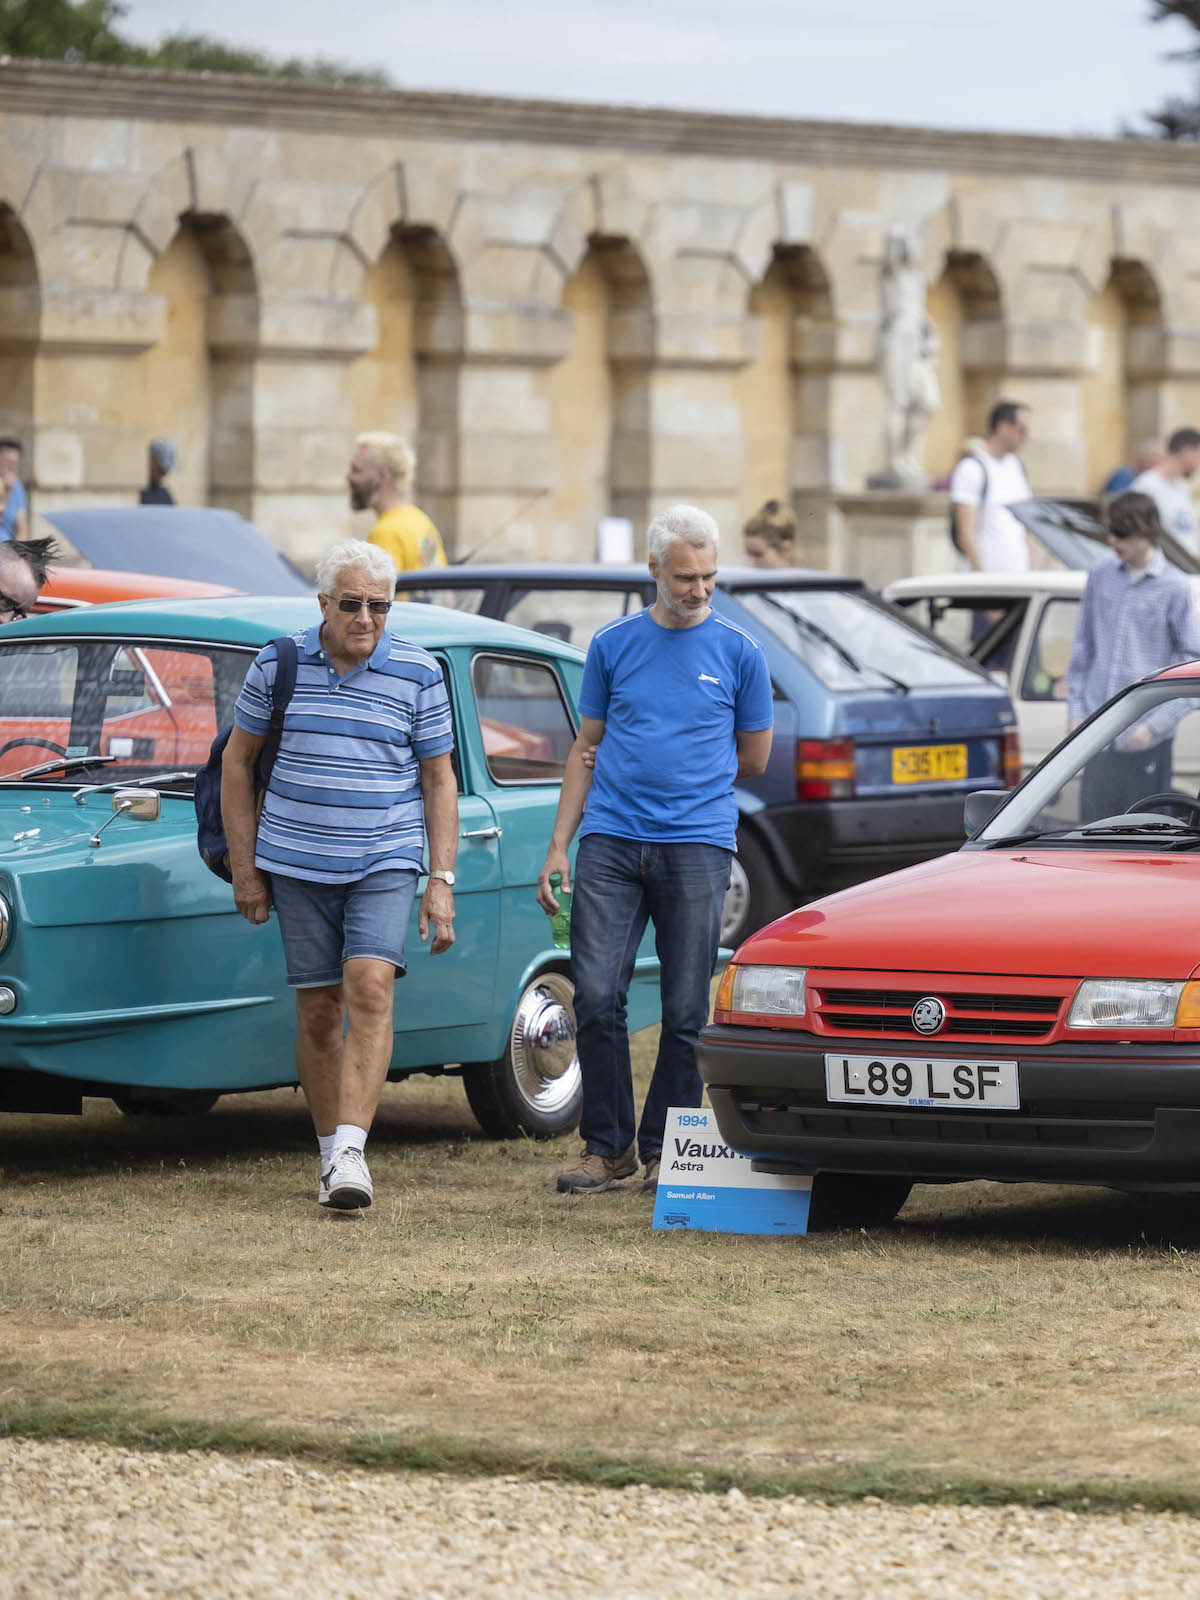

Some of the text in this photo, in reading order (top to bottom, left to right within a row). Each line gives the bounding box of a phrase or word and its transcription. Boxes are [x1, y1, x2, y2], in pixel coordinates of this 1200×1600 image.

[842, 1059, 1000, 1100] L89 LSF
[908, 1098, 934, 1106] BELMONT
[677, 1115, 708, 1127] 1994
[670, 1160, 704, 1172] Astra
[666, 1191, 716, 1200] Samuel Allan
